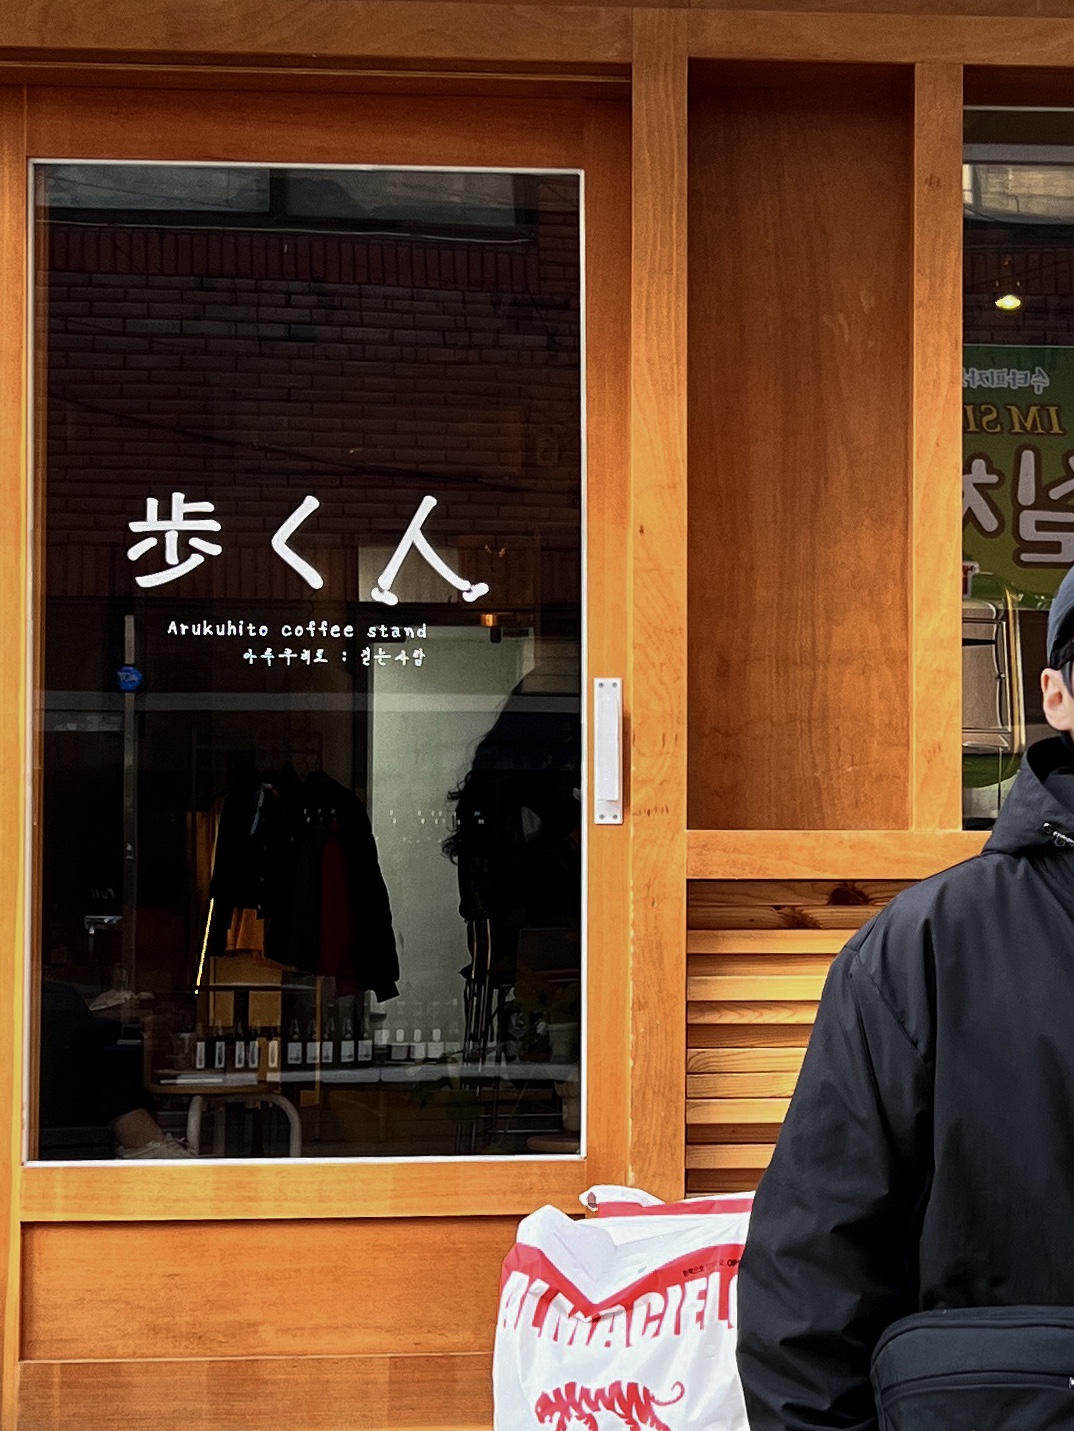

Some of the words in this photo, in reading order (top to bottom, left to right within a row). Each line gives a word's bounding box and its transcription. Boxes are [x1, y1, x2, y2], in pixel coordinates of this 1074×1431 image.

[127, 491, 490, 605] 歩く人
[167, 620, 269, 637] Arukuhito
[281, 621, 354, 637] coffee
[367, 623, 427, 638] stand
